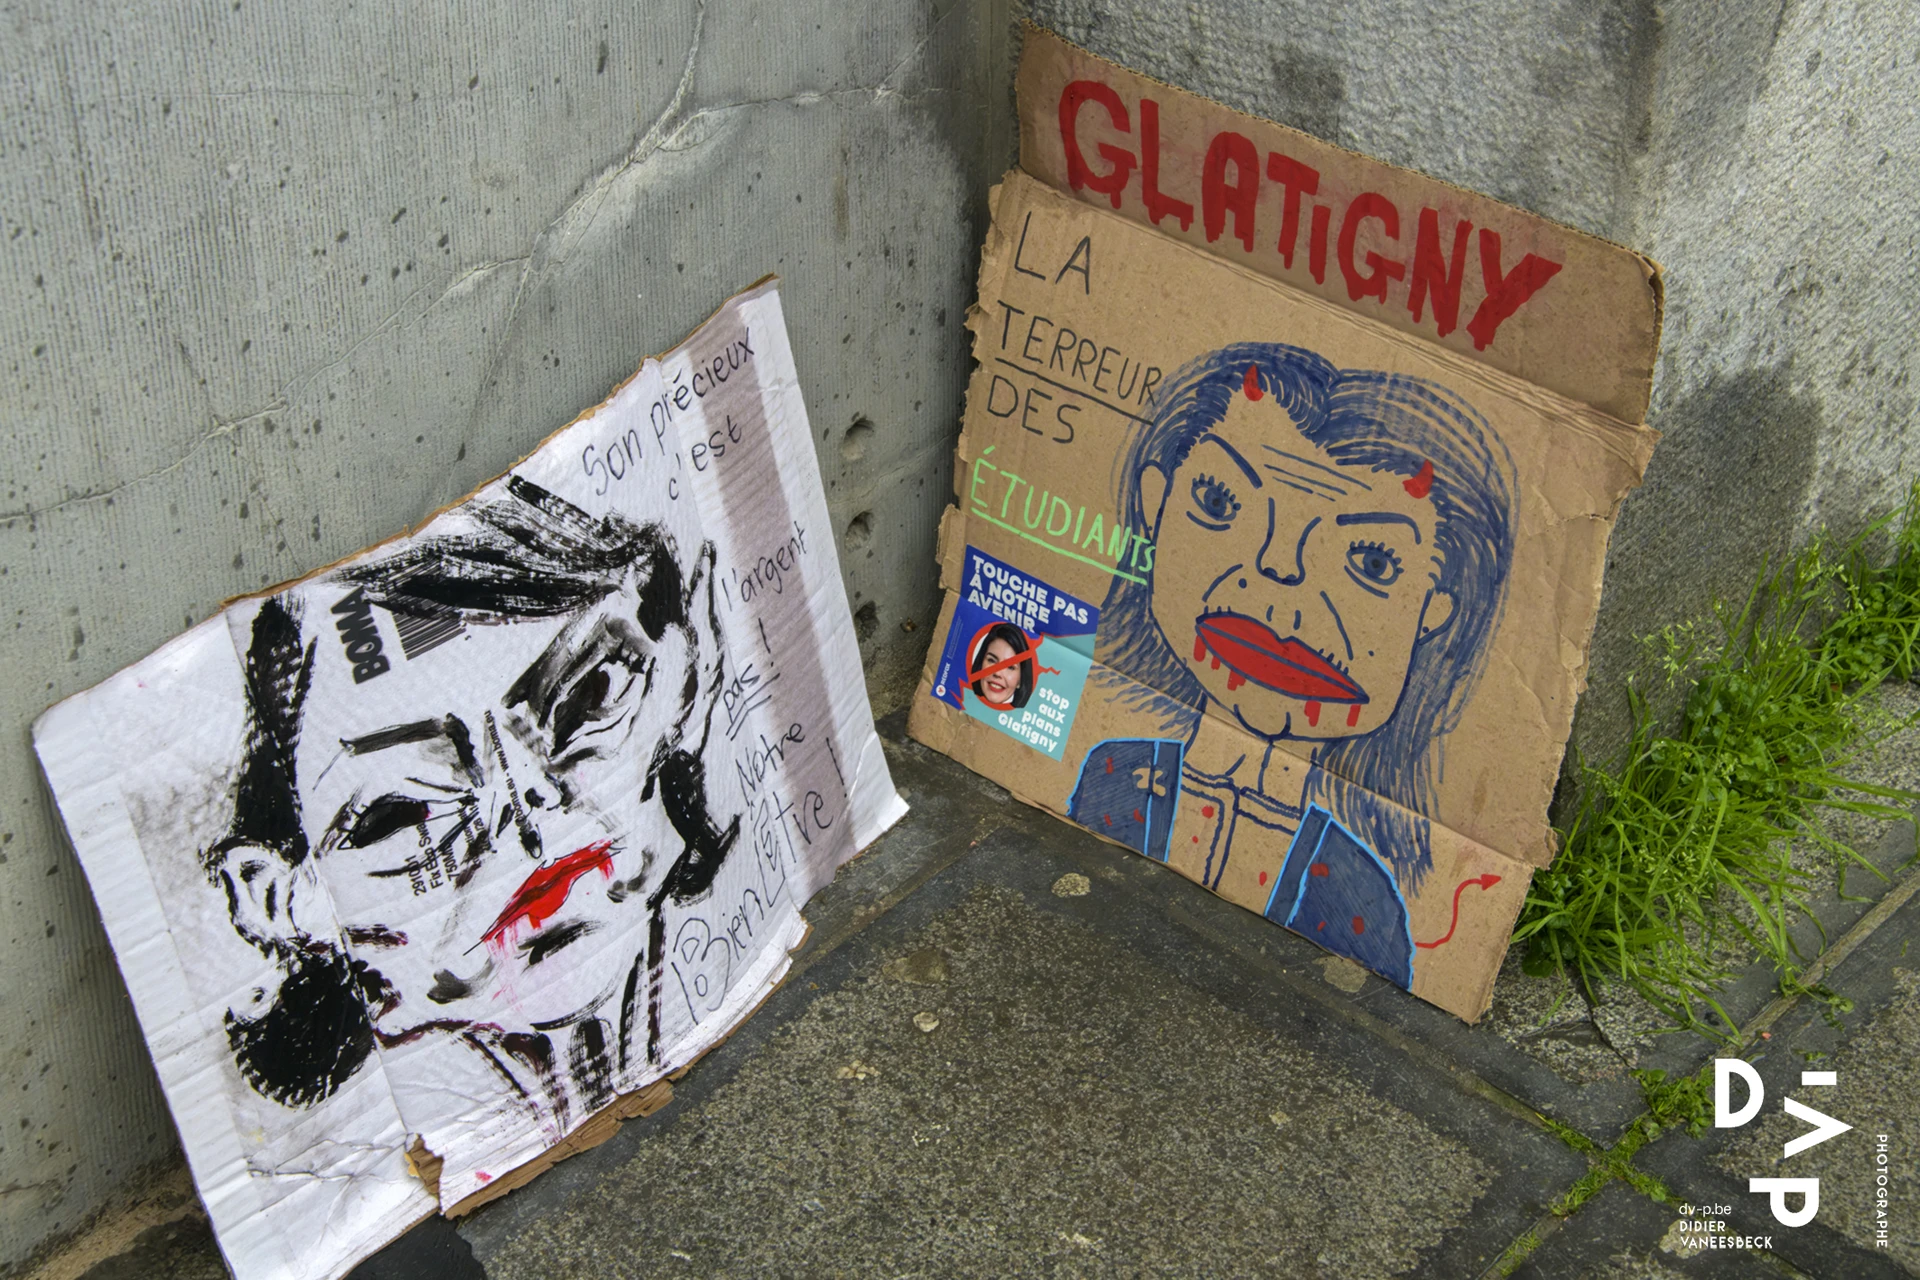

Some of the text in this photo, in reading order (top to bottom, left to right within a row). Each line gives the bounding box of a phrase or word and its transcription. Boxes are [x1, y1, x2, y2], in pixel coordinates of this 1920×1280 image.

[1058, 80, 1563, 352] GLATIGNY
[1014, 211, 1091, 295] LA
[997, 299, 1162, 406] TERREUR
[582, 327, 755, 496] Son précieux
[987, 375, 1082, 444] DES
[970, 445, 1156, 573] ÉTUDIANTS
[722, 520, 807, 612] l'argent
[969, 568, 1050, 624] À NOTRE
[972, 554, 1089, 625] TOUCHE PAS
[330, 585, 390, 685] BOMA
[967, 591, 1036, 633] AVENIR
[998, 712, 1058, 753] Glatigny
[1022, 710, 1061, 738] plans
[1038, 687, 1069, 710] stop
[1038, 703, 1066, 724] aux
[484, 710, 508, 771] www.boma.eu
[429, 868, 444, 889] Fix
